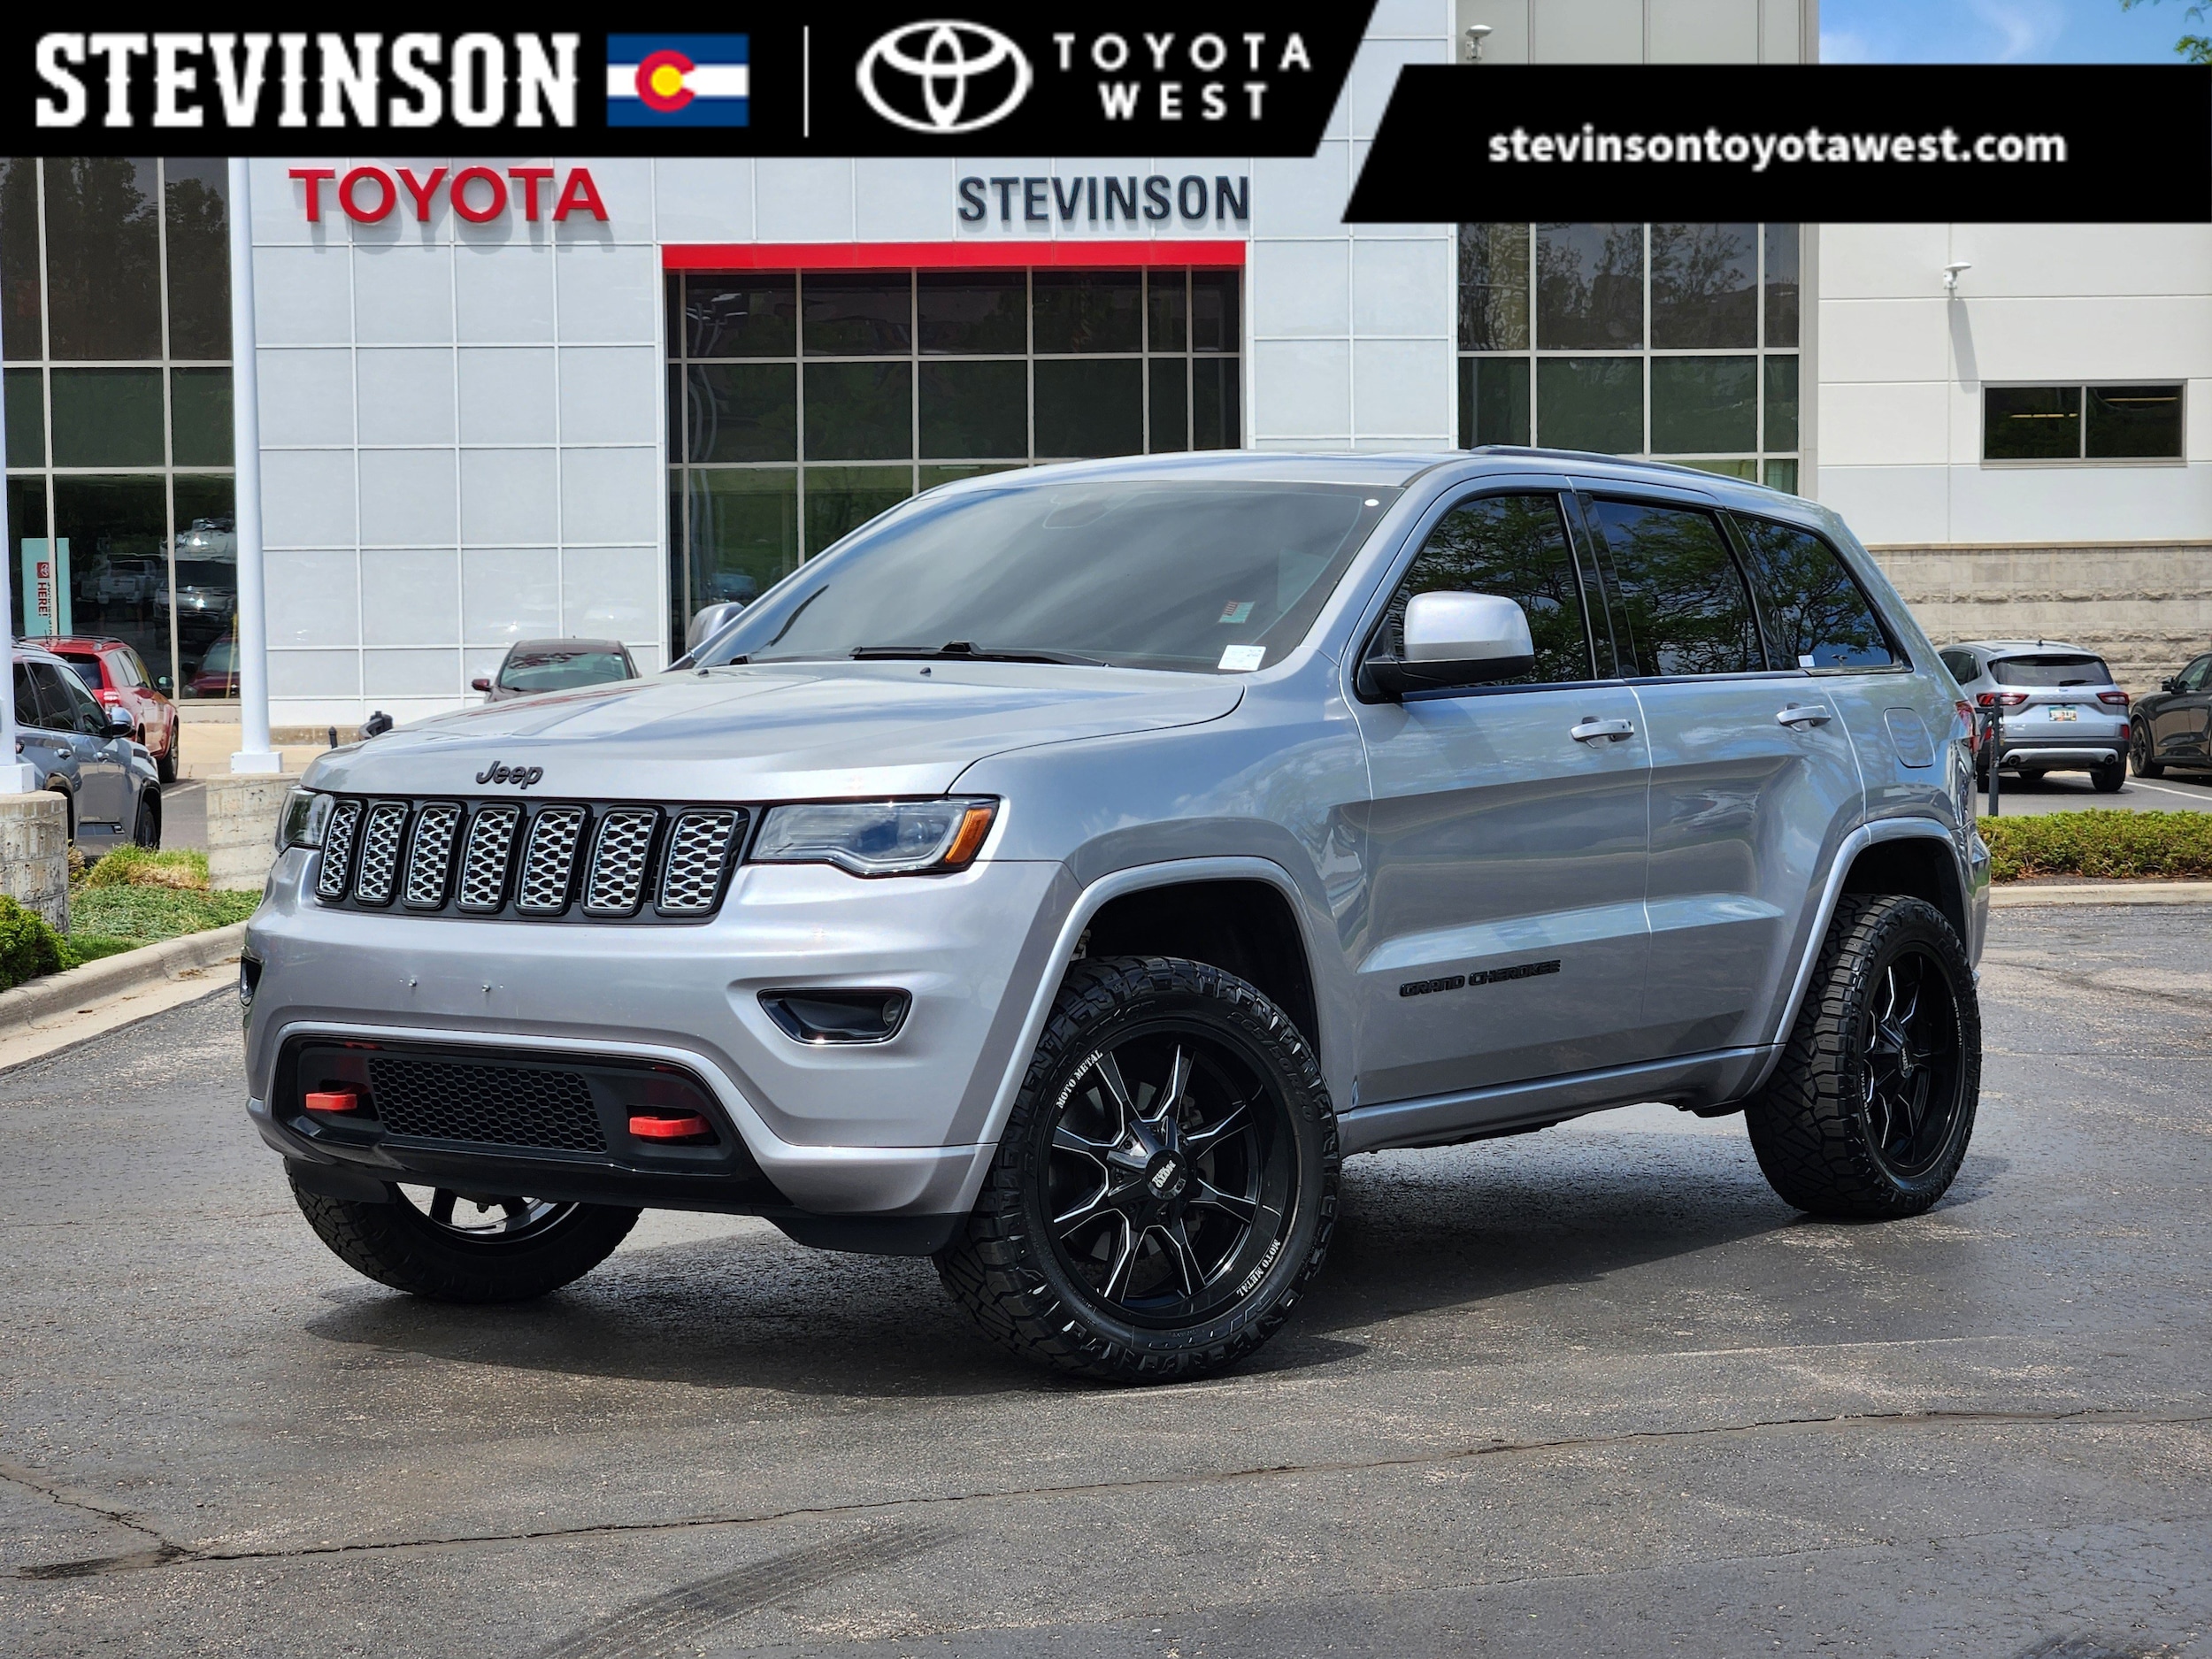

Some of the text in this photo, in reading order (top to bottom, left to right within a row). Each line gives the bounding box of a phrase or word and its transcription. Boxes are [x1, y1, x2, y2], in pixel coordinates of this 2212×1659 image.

[289, 166, 607, 222] TOYOTA
[961, 178, 1247, 220] STEVINSON
[38, 582, 48, 617] HERE!
[476, 760, 544, 790] Jeep
[1399, 960, 1562, 997] GRAND CHEROKEE
[1056, 1049, 1104, 1110] MOTO METAL
[1235, 1238, 1281, 1297] MOTO METAL
